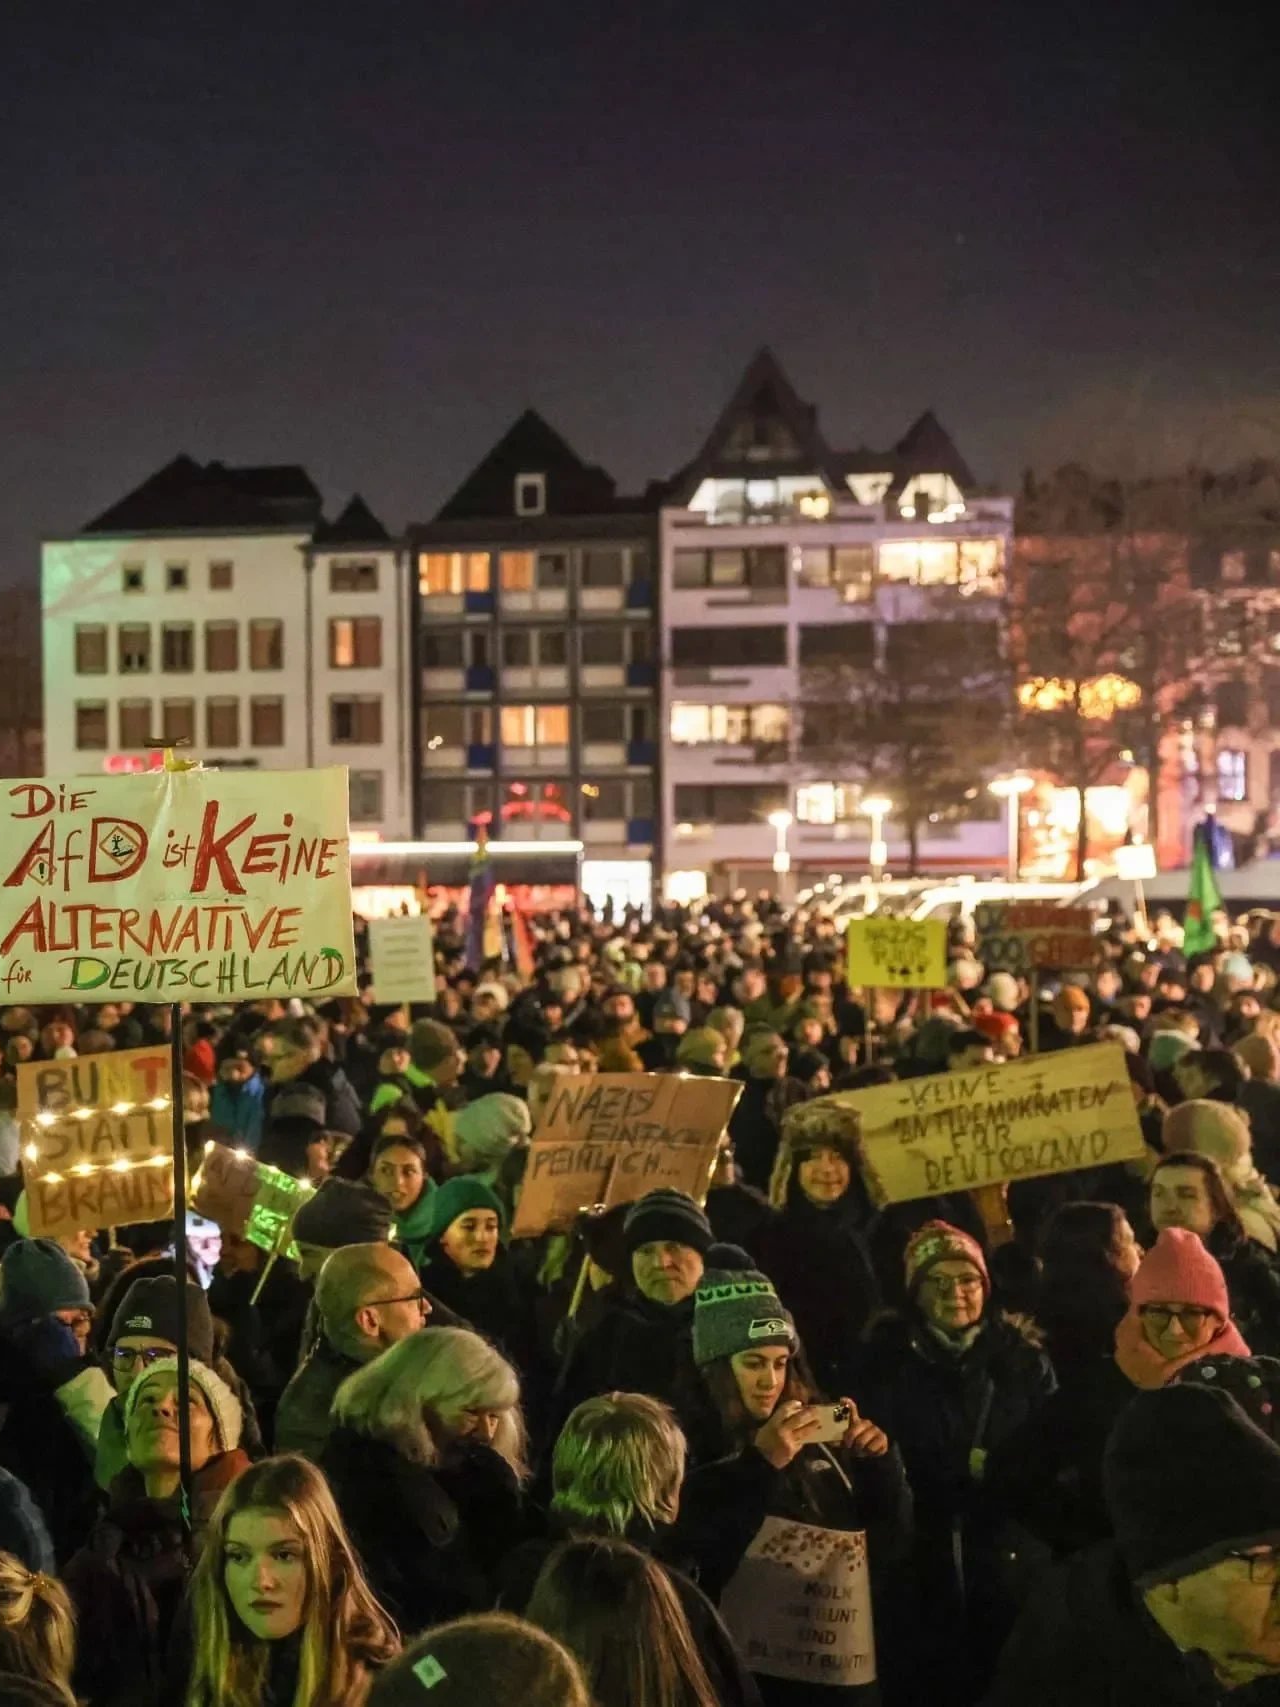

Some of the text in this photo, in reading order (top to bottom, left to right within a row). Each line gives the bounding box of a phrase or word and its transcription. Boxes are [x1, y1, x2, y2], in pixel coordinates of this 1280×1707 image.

[3, 817, 149, 892] AfD
[162, 829, 196, 869] ist
[58, 947, 345, 994] DEUTSCHLAND
[36, 1055, 169, 1110] BUNT
[548, 1084, 655, 1128] NAZIS
[43, 1111, 161, 1160] STATT
[924, 1128, 1109, 1191] DEUTSCHLAND
[39, 1171, 170, 1228] BRAUN
